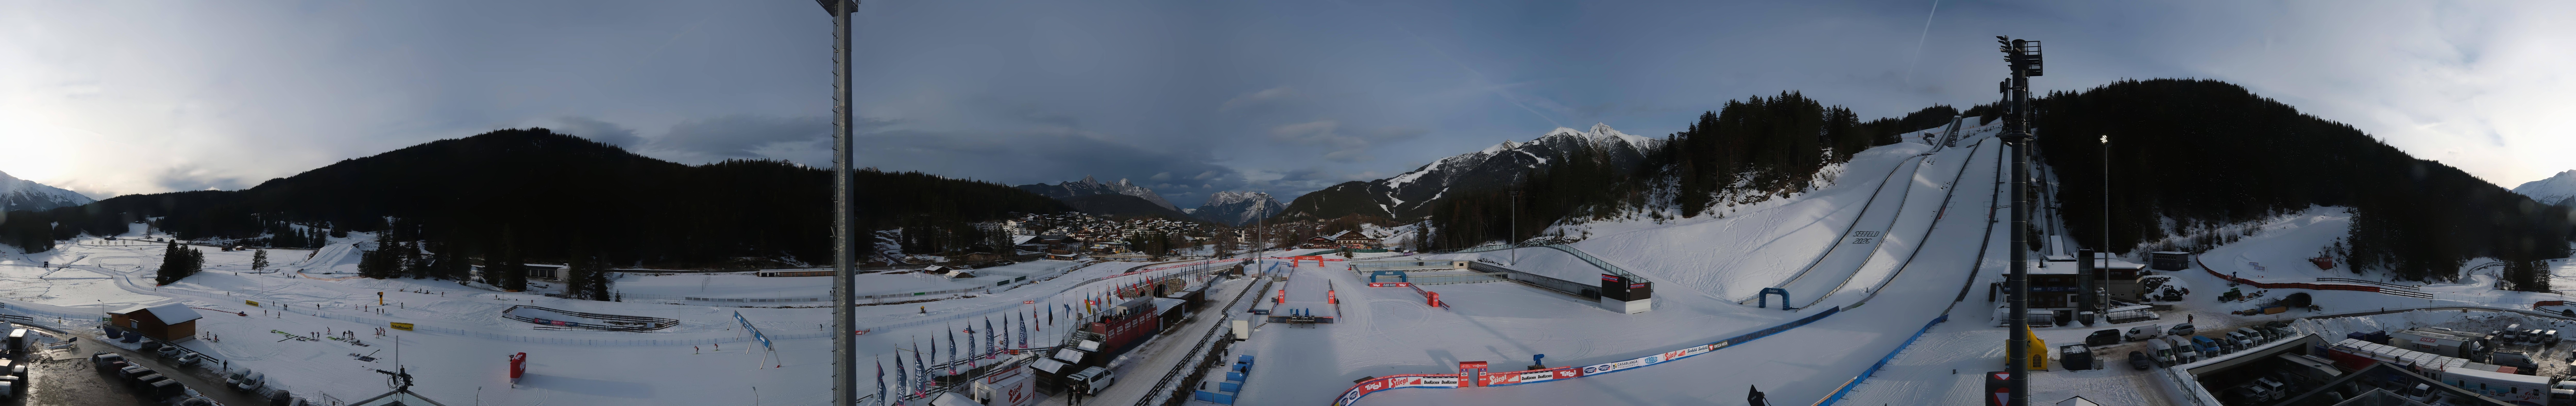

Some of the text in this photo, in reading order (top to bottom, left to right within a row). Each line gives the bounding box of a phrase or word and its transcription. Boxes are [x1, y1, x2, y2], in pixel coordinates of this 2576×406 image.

[1665, 351, 1677, 361] Stiegl
[1391, 377, 1408, 388] Stiegl
[1489, 375, 1506, 385] Stiegl
[1365, 382, 1381, 390] Tirol
[1008, 382, 1023, 403] Stiegl
